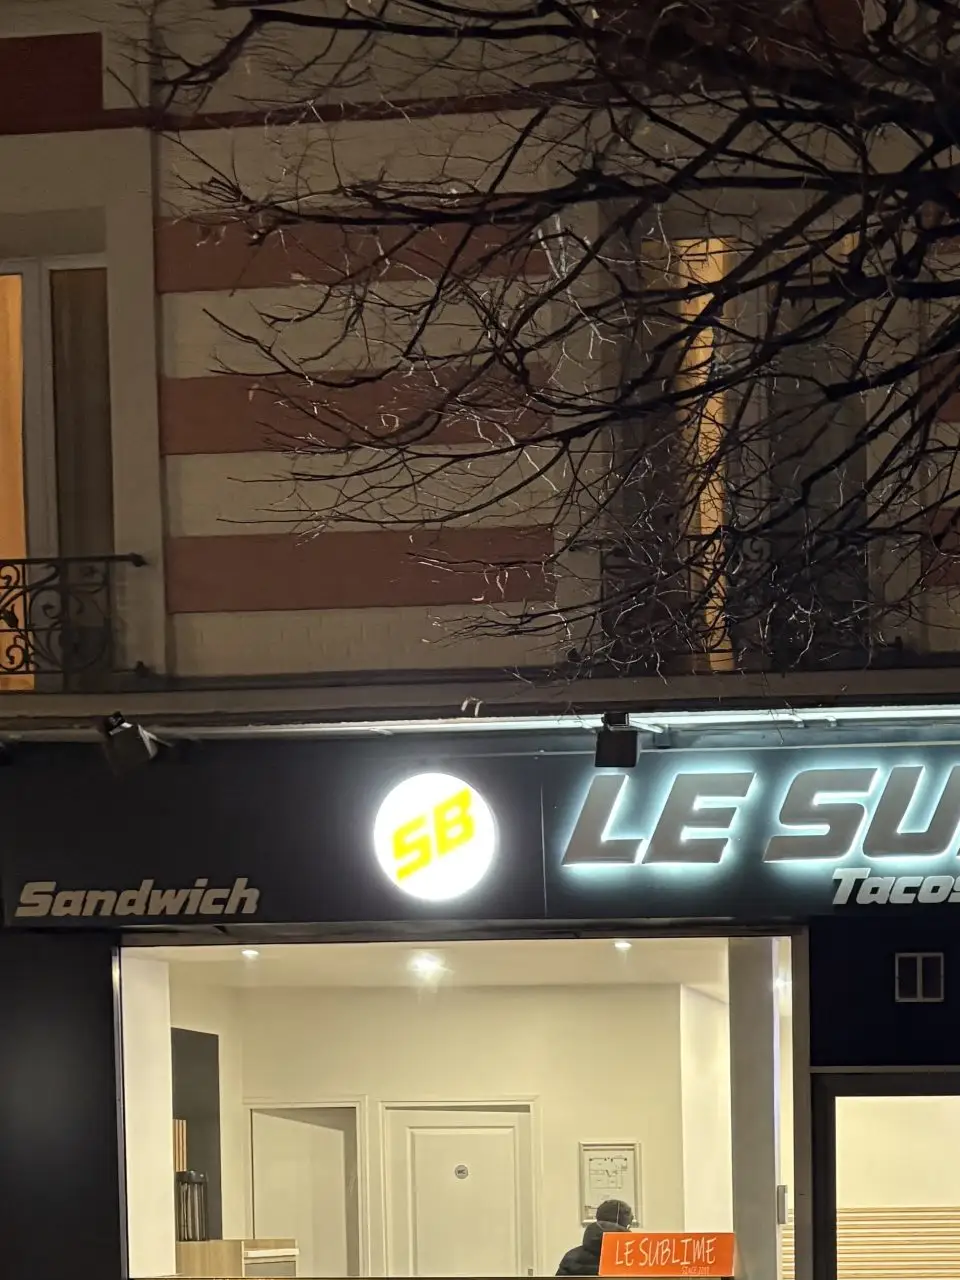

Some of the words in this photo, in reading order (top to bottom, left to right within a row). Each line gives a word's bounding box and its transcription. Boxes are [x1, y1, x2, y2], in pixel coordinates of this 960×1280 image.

[391, 786, 475, 882] SB
[562, 772, 756, 866] LE
[14, 878, 260, 918] Sandwich
[615, 1239, 636, 1267] LE
[639, 1236, 717, 1267] SUBLIME
